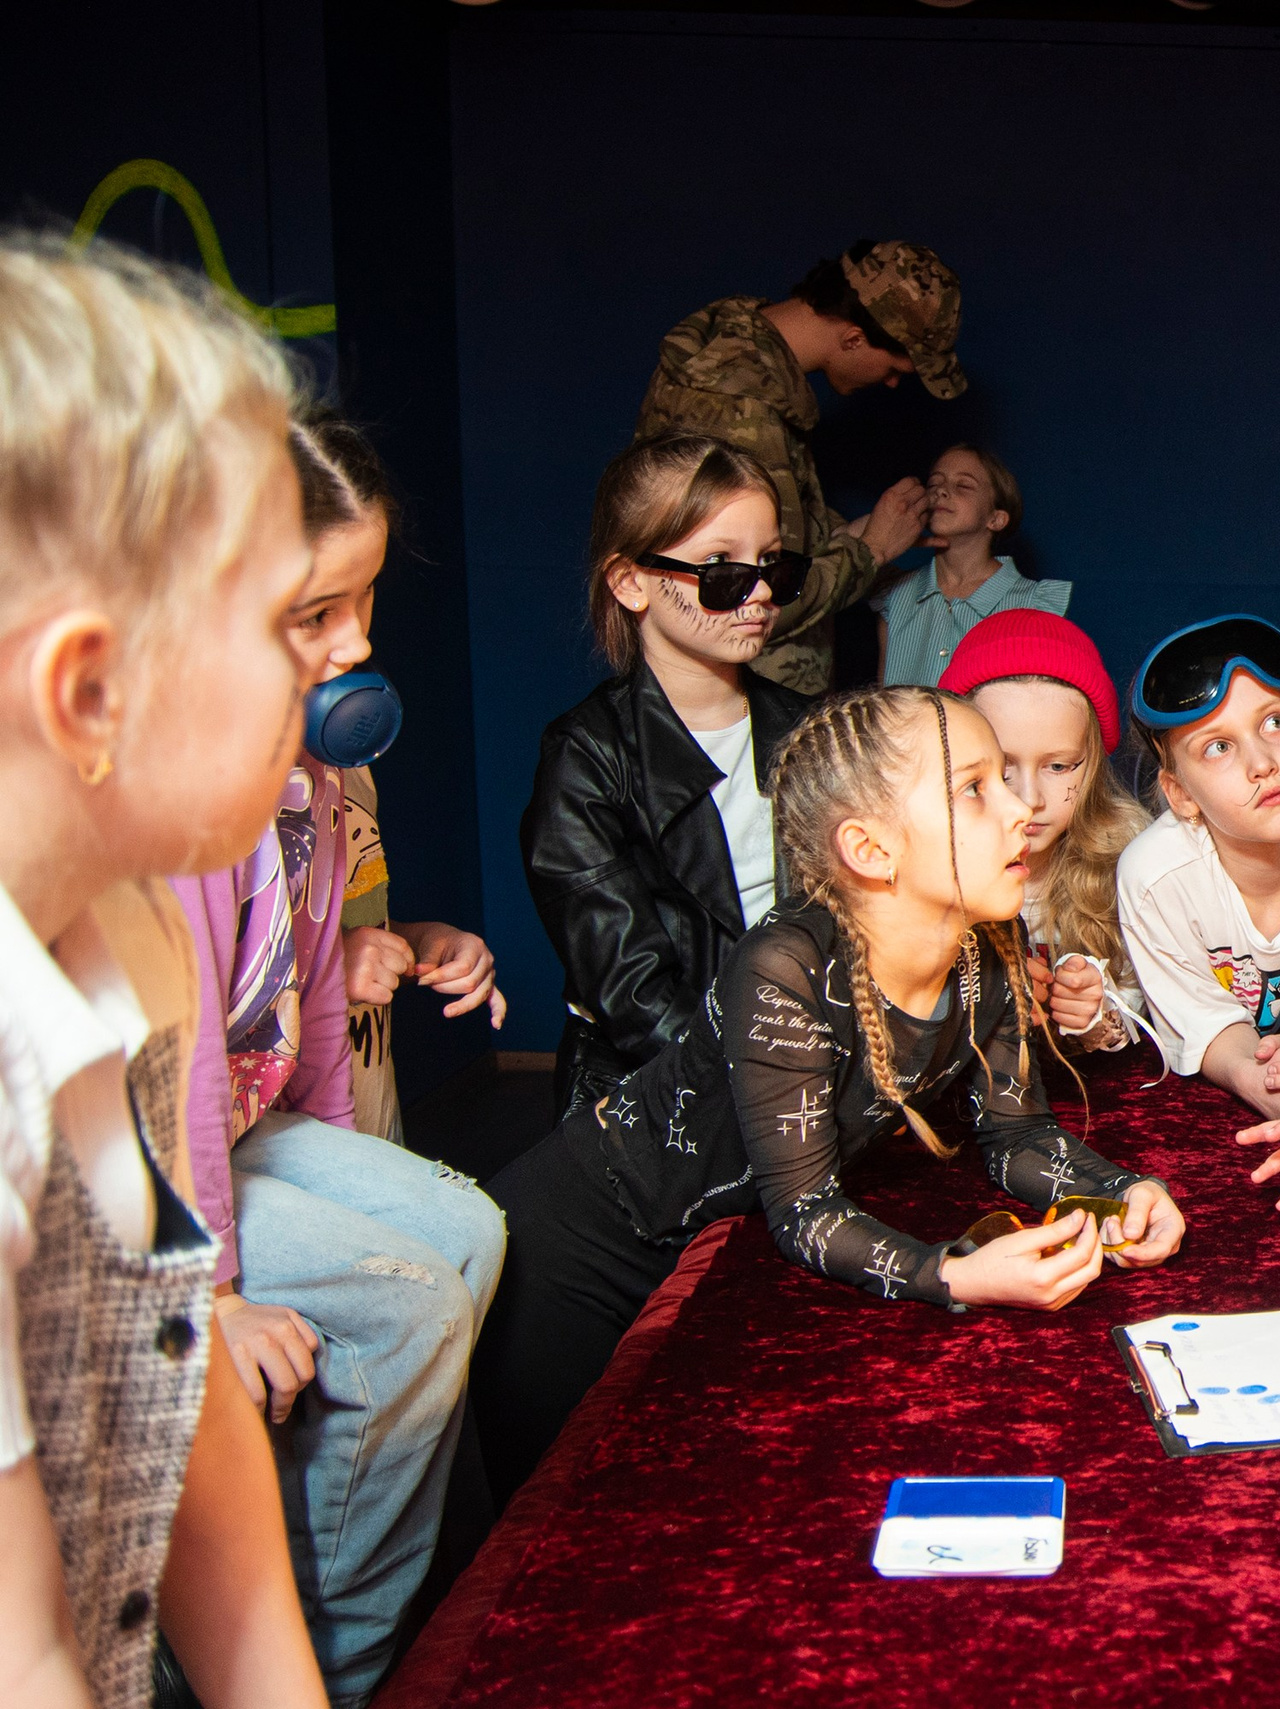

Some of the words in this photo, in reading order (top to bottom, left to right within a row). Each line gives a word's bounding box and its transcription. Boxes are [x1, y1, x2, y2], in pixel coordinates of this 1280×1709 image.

[787, 1013, 810, 1030] the
[748, 1024, 769, 1043] love
[767, 1033, 819, 1052] yourself
